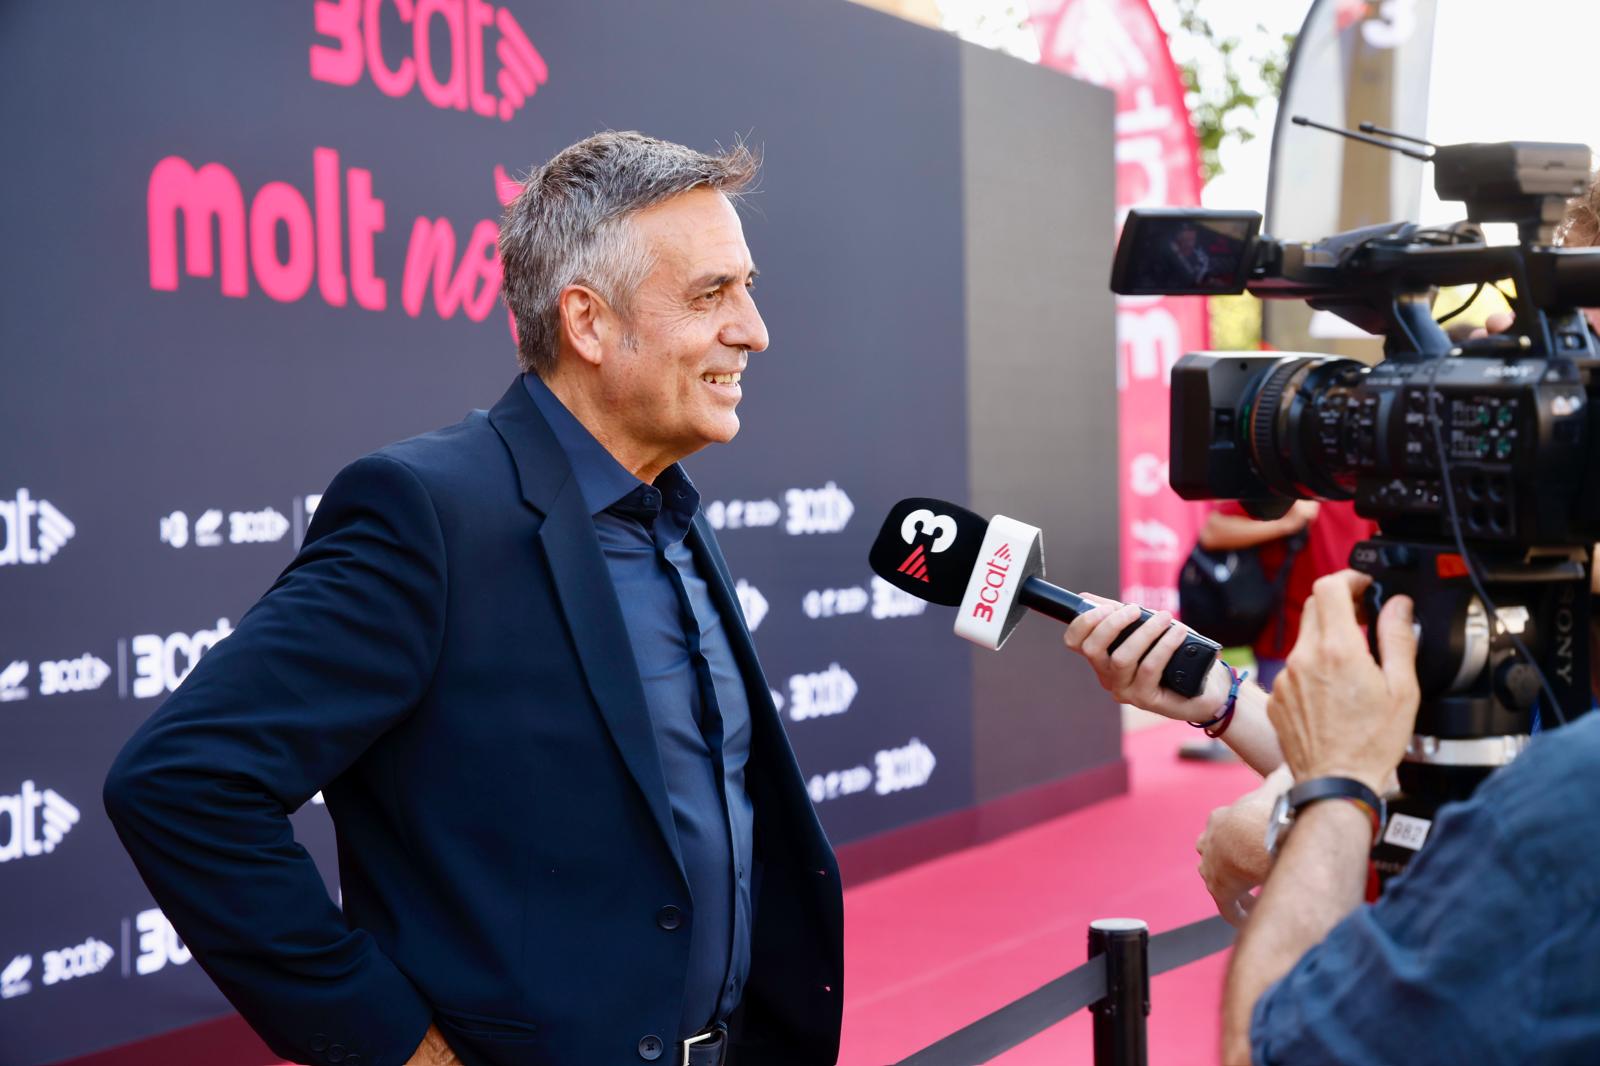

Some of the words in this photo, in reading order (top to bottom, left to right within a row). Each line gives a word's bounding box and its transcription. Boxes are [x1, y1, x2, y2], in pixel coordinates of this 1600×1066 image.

[309, 0, 500, 118] 3cat
[147, 146, 387, 311] molt
[901, 509, 958, 553] 3
[972, 556, 1011, 622] 3cat
